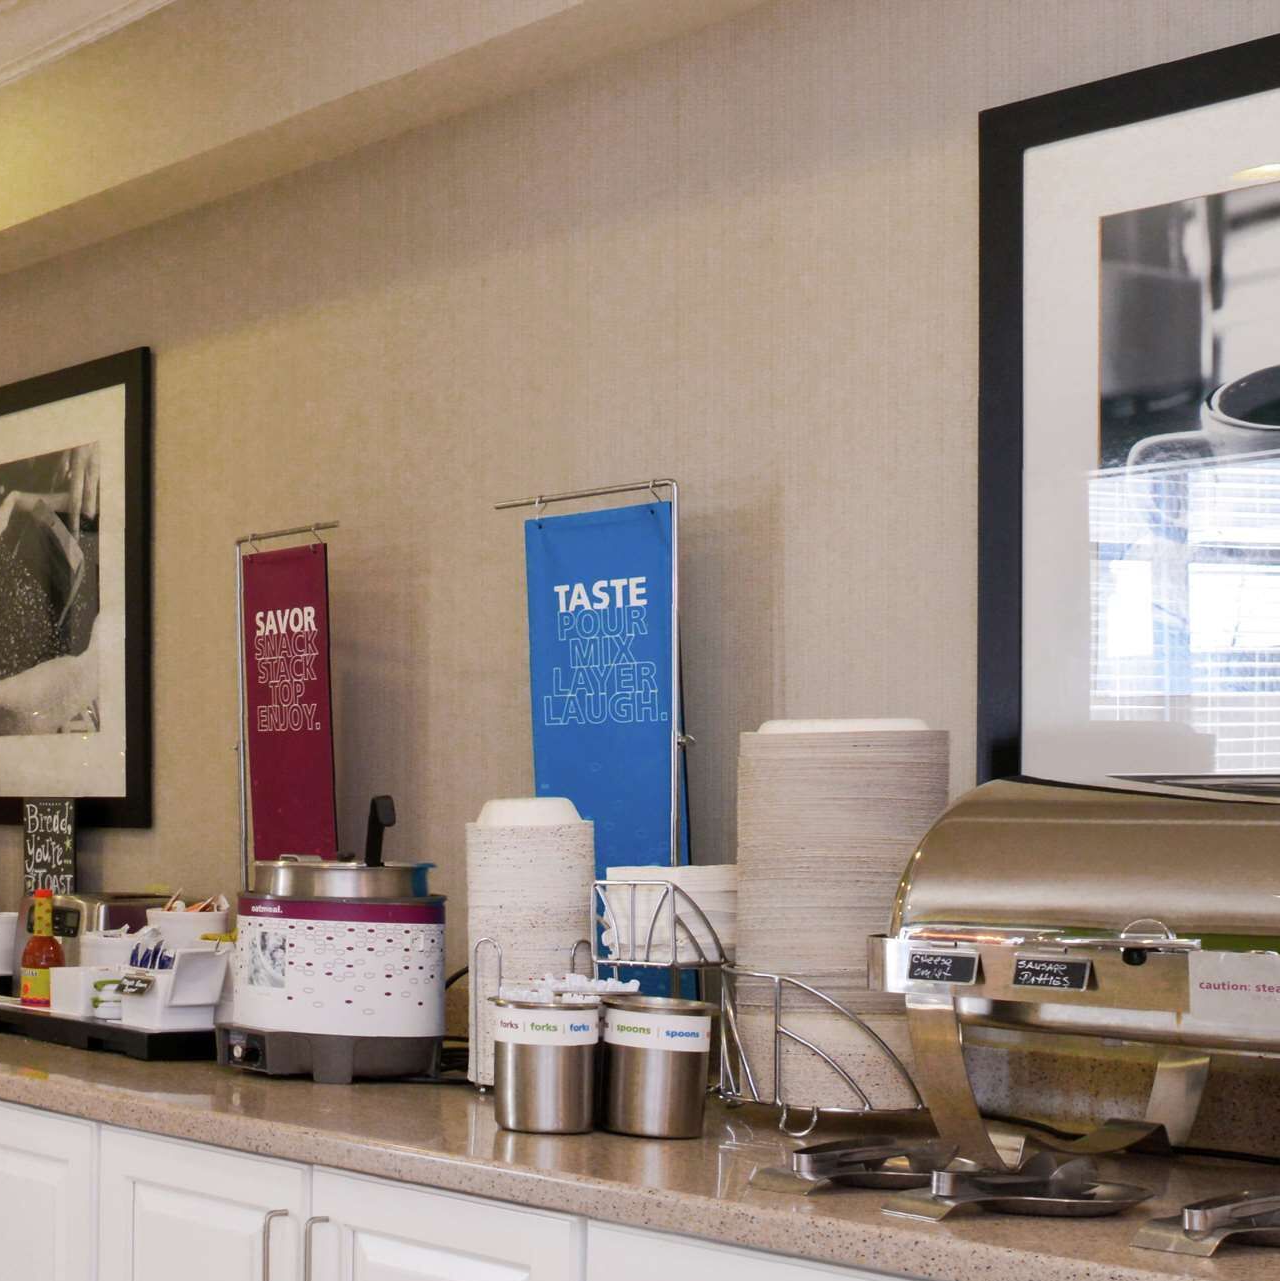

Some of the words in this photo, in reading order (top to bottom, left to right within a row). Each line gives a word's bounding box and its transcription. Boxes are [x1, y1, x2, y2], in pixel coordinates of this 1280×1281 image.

[553, 576, 648, 613] TASTE
[255, 605, 318, 636] SAVOR
[557, 605, 648, 641] POUR
[254, 630, 319, 660] SNACK
[569, 634, 637, 669] MIX
[258, 653, 318, 684] STACK
[553, 661, 658, 697] LAYER
[268, 679, 306, 707] TOP
[543, 690, 669, 726] LAUGH.
[257, 703, 321, 733] ENJOY.
[1199, 981, 1251, 992] caution:
[499, 1019, 519, 1031] forks
[529, 1022, 559, 1033] forks
[616, 1023, 652, 1036] spoons
[664, 1029, 701, 1040] spoons
